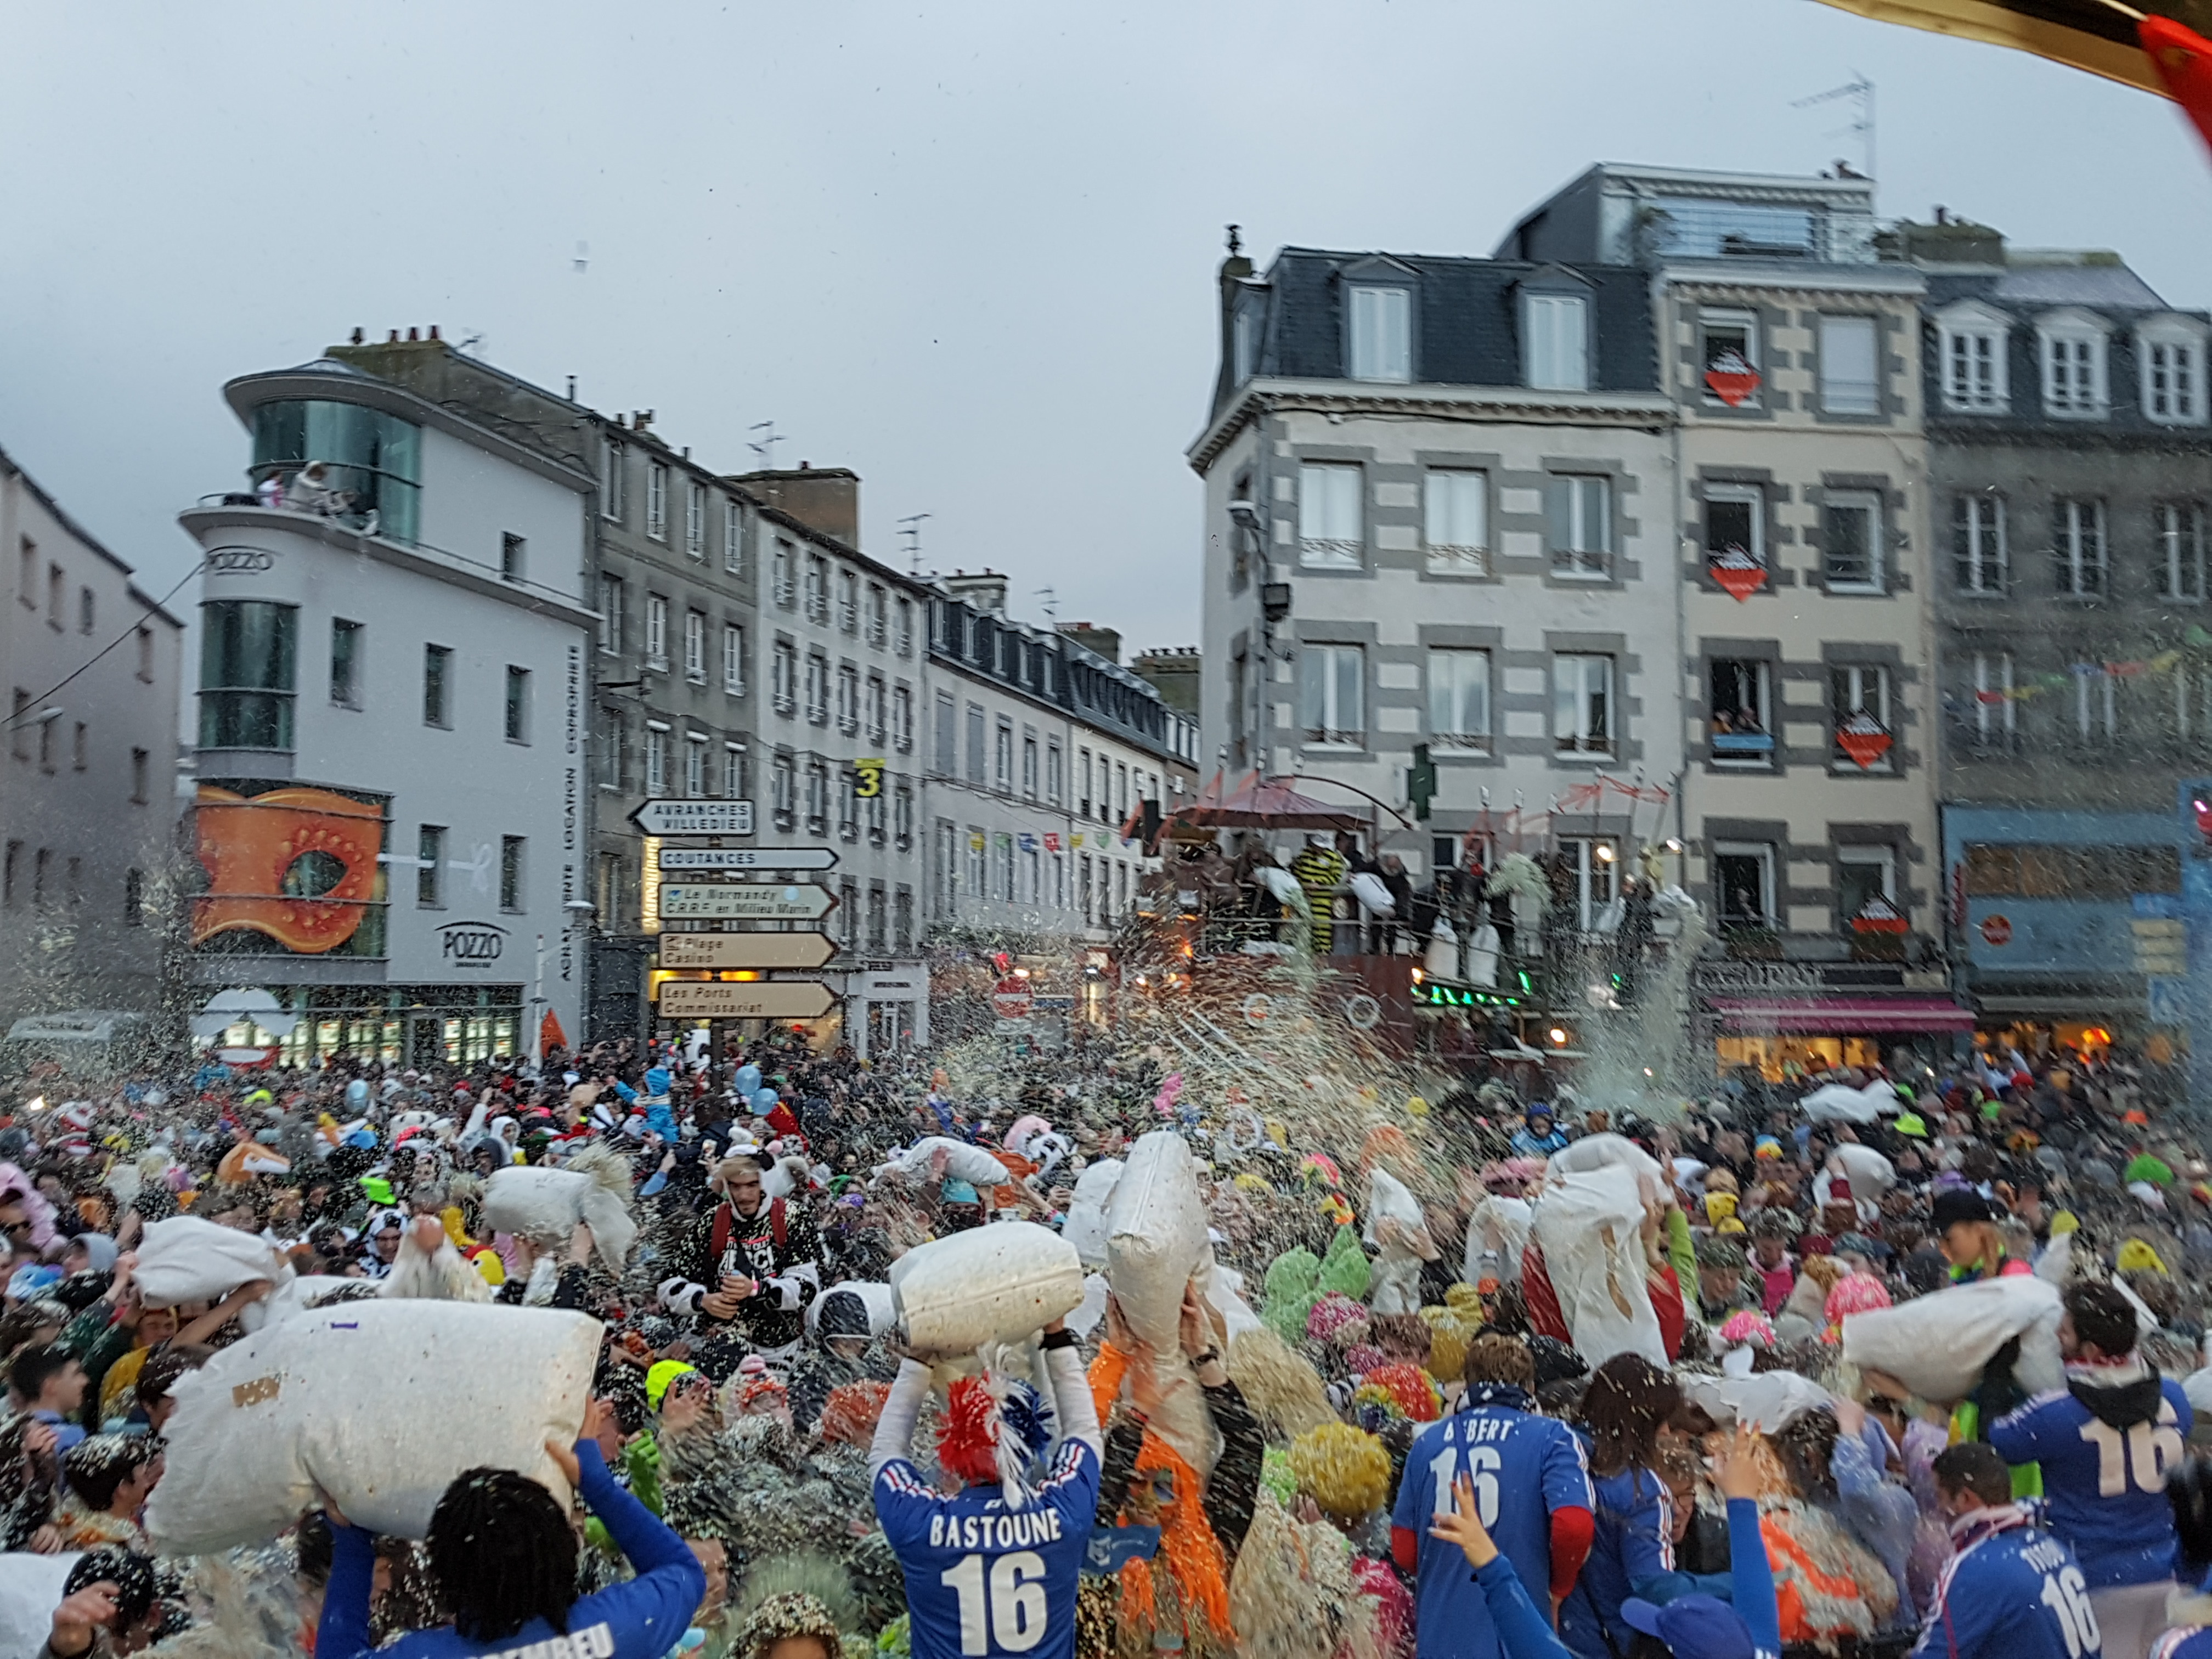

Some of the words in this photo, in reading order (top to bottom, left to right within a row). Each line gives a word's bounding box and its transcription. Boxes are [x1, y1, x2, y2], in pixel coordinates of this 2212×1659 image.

[856, 768, 881, 797] 3
[563, 768, 577, 850] LOCATION
[653, 804, 748, 816] AVRANCHES
[662, 819, 749, 830] VILLEDIEU
[663, 853, 755, 864] COUTANCES
[684, 889, 701, 899] Le
[443, 932, 502, 960] POZZO
[664, 952, 714, 963] Casino
[663, 987, 688, 998] Les
[693, 987, 733, 998] Ports
[663, 1002, 762, 1014] Commissariat
[2078, 1395, 2184, 1498] 16
[1429, 1444, 1502, 1529] 16
[929, 1507, 1062, 1549] BASTOUNE
[941, 1550, 1048, 1657] 16
[2040, 1564, 2102, 1658] 16
